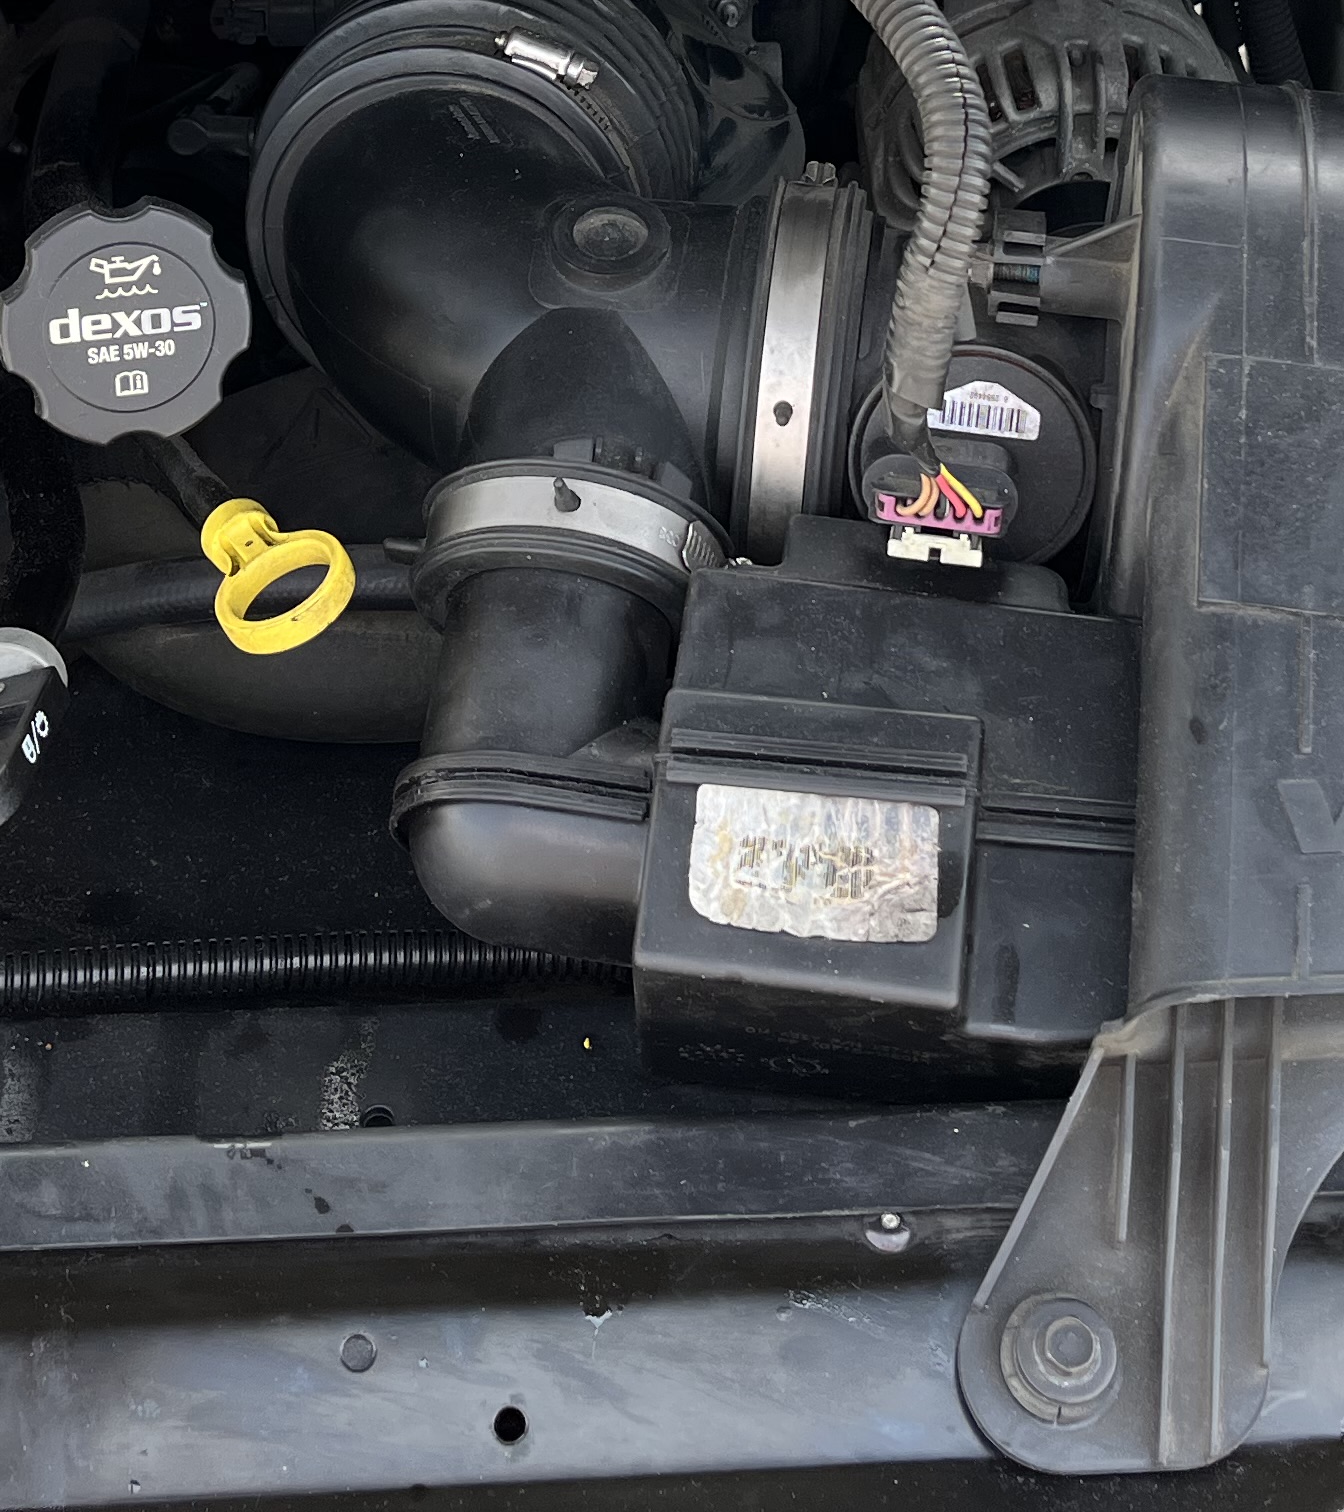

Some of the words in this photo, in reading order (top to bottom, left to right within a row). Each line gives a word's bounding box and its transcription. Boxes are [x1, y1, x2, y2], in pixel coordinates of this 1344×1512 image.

[49, 304, 202, 345] dexos
[87, 345, 121, 365] SAE
[123, 339, 176, 361] 5W-30
